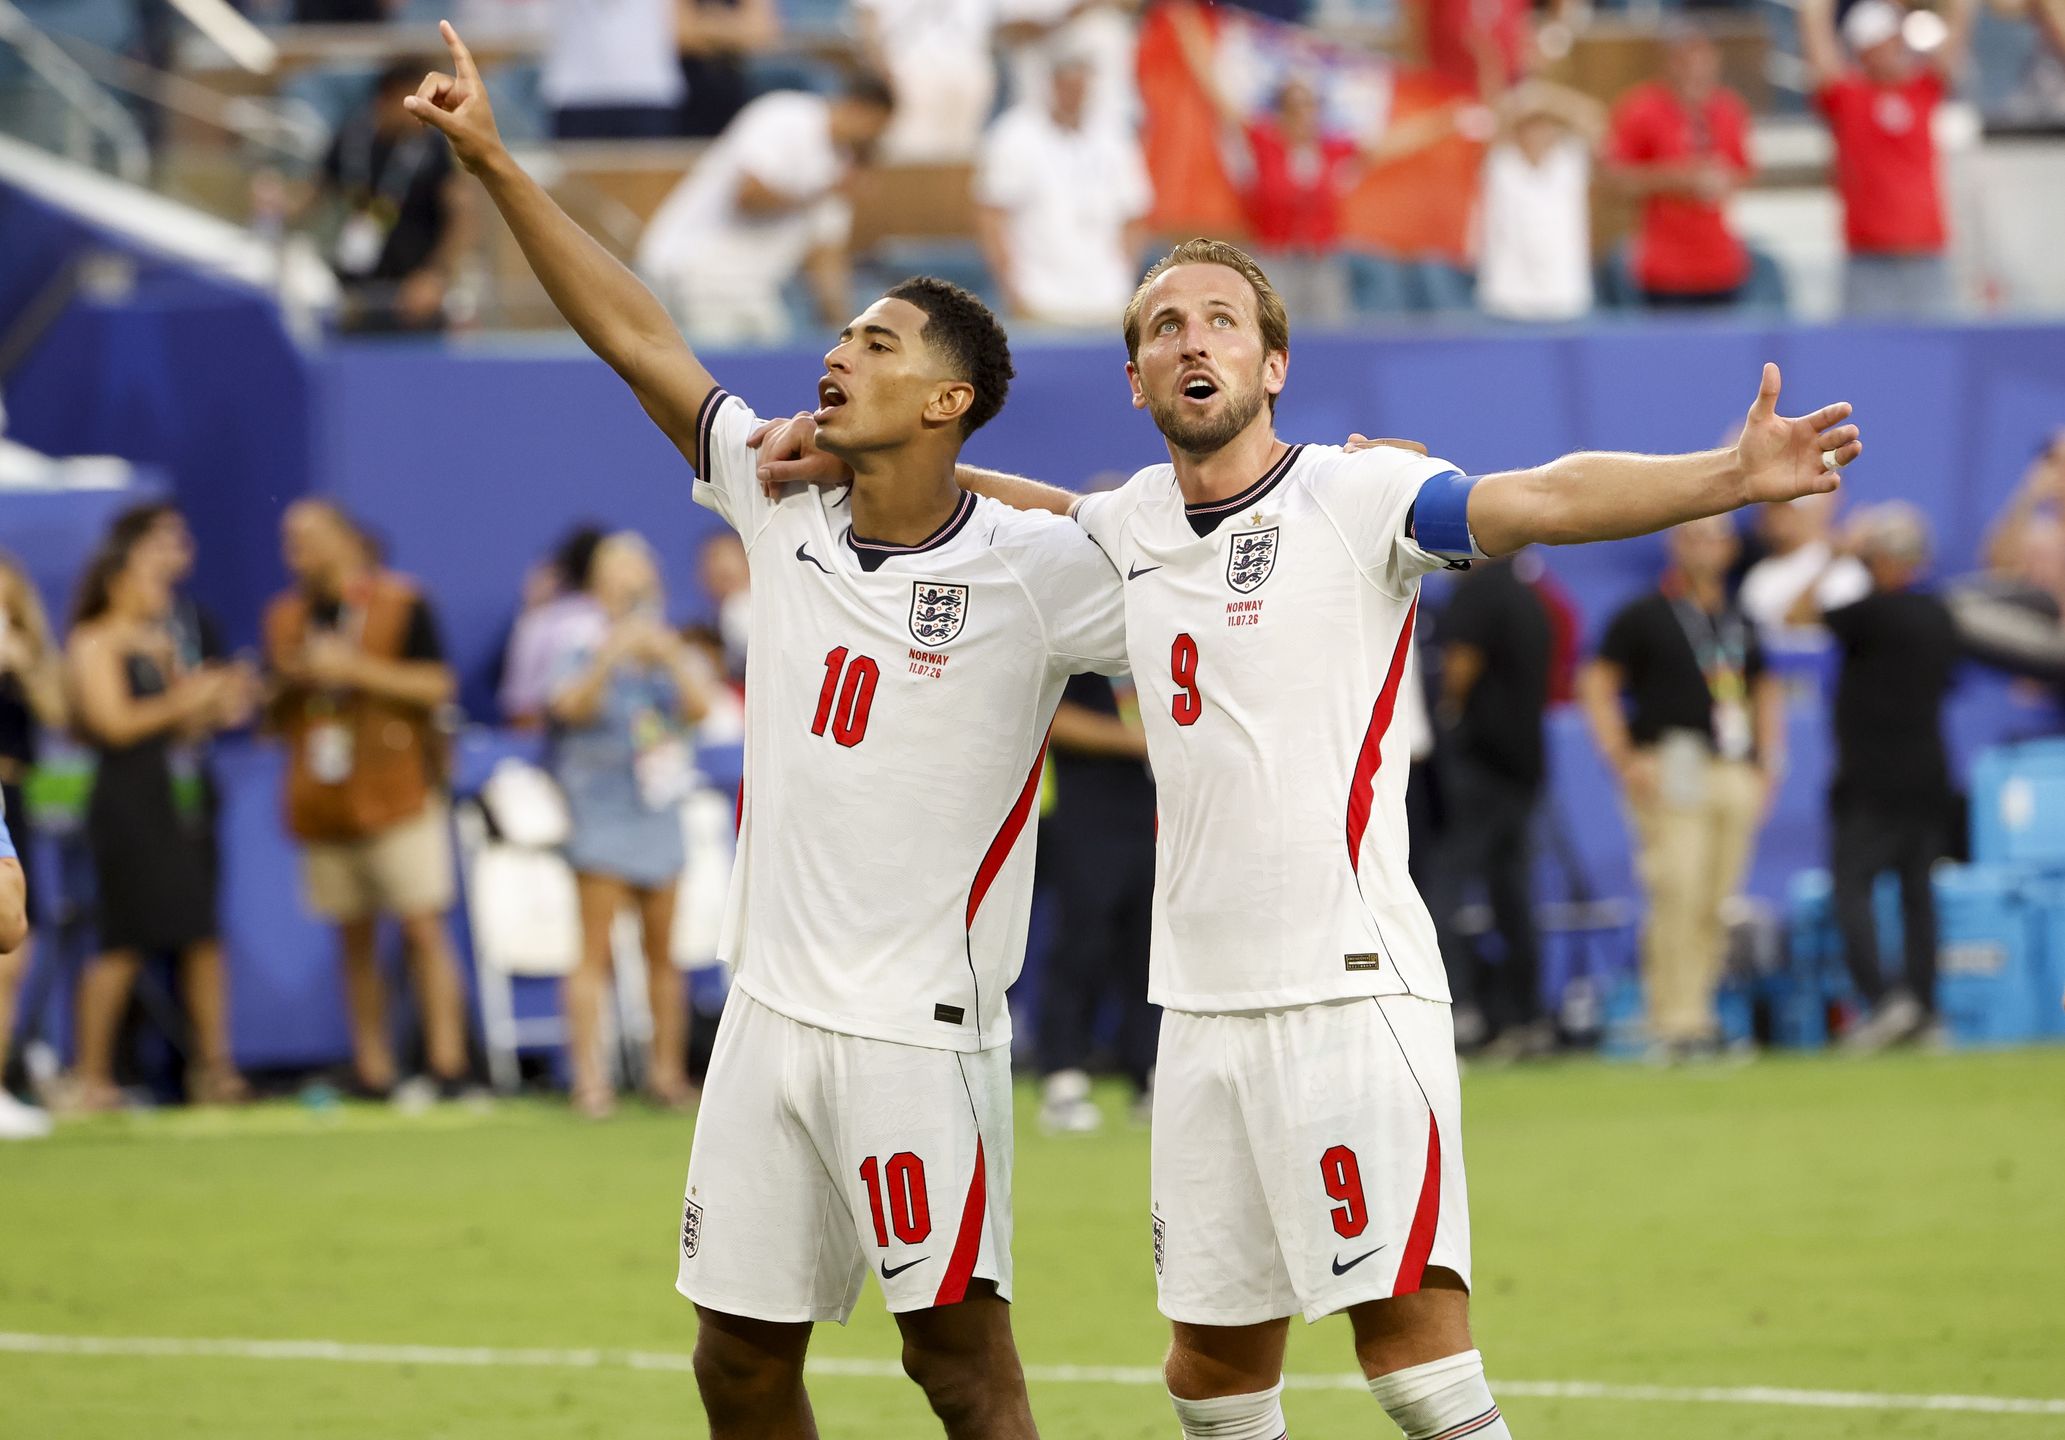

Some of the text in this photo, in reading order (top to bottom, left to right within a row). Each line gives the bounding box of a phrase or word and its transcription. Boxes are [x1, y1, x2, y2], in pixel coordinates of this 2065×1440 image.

[1226, 600, 1264, 613] NORWAY
[1228, 614, 1259, 627] 11.07.26
[909, 648, 949, 666] NORWAY
[909, 662, 942, 679] 11.07.26
[1171, 633, 1202, 726] 9
[811, 645, 880, 748] 10
[859, 1151, 932, 1247] 10
[1320, 1144, 1369, 1239] 9
